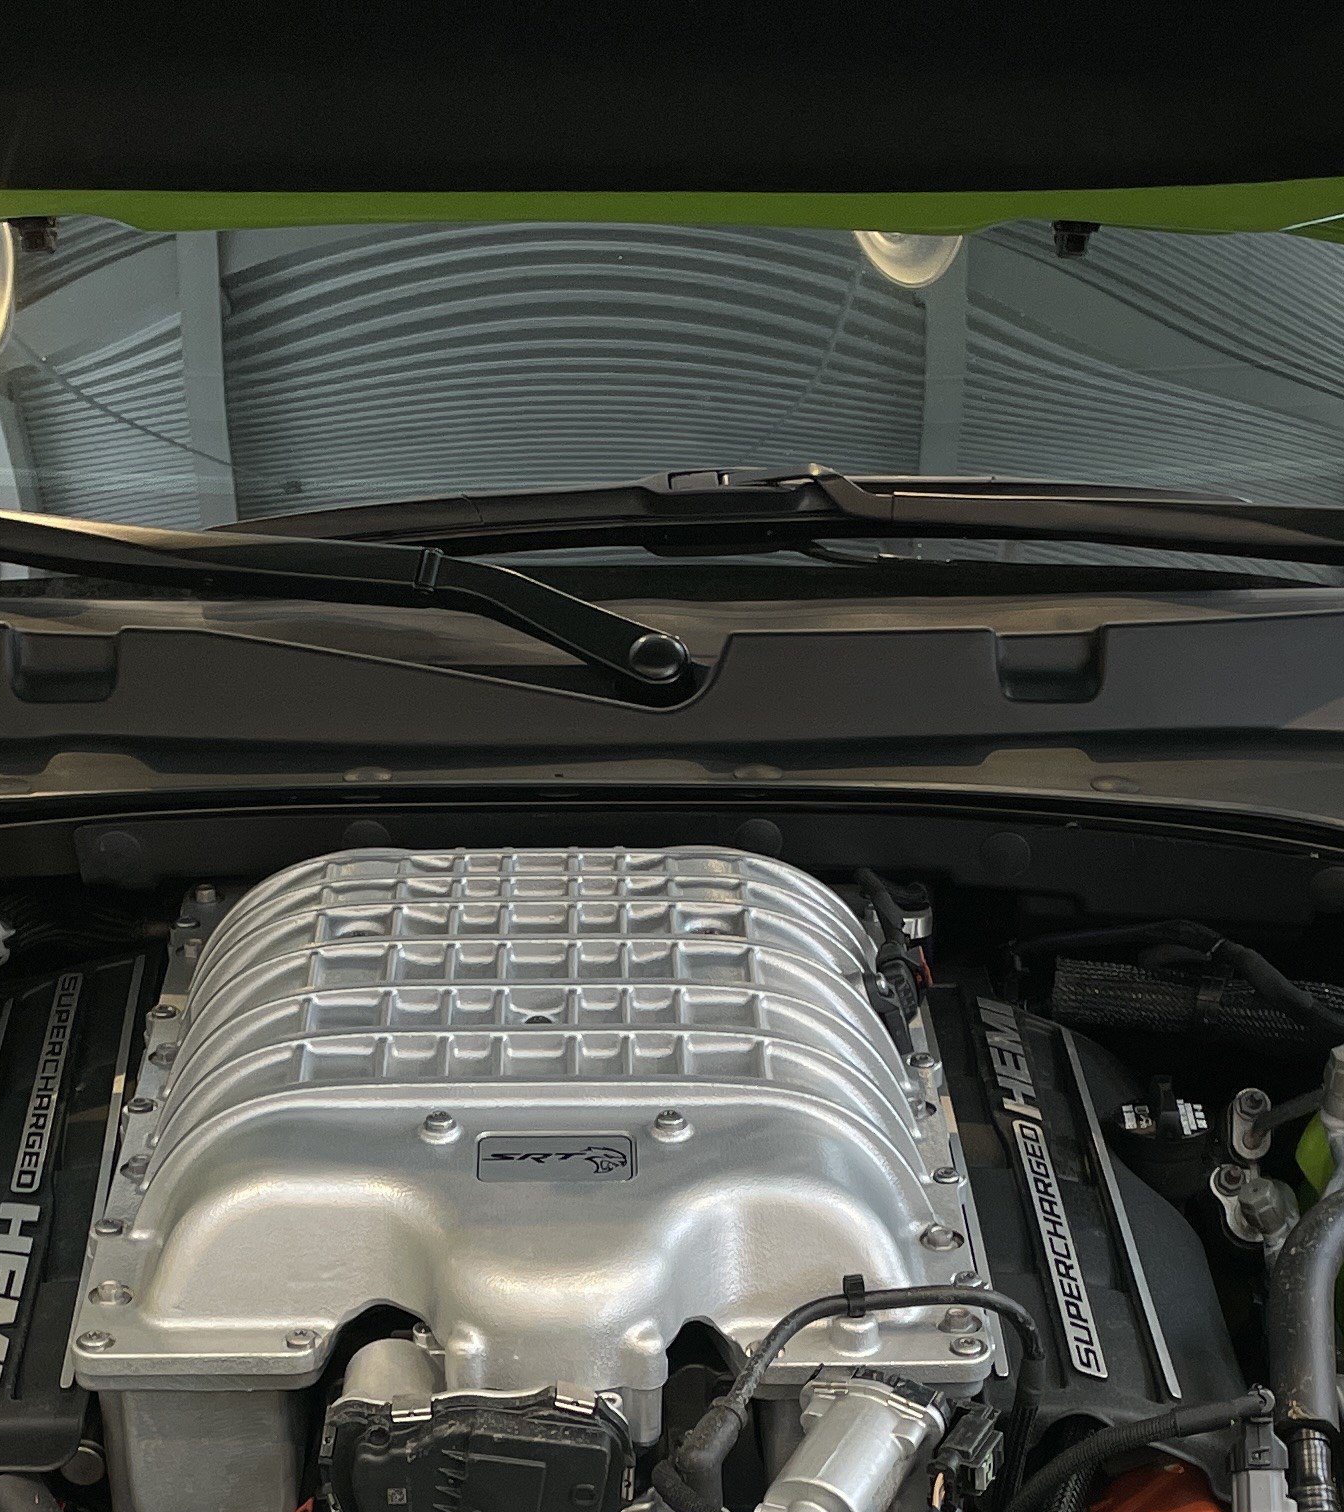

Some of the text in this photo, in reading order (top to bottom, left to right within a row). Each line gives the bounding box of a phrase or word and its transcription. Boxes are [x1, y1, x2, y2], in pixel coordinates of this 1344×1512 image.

[16, 975, 77, 1189] SUPERCHARGED
[482, 1151, 587, 1163] SRT
[976, 996, 1102, 1373] SUPERCHARGED HEMI
